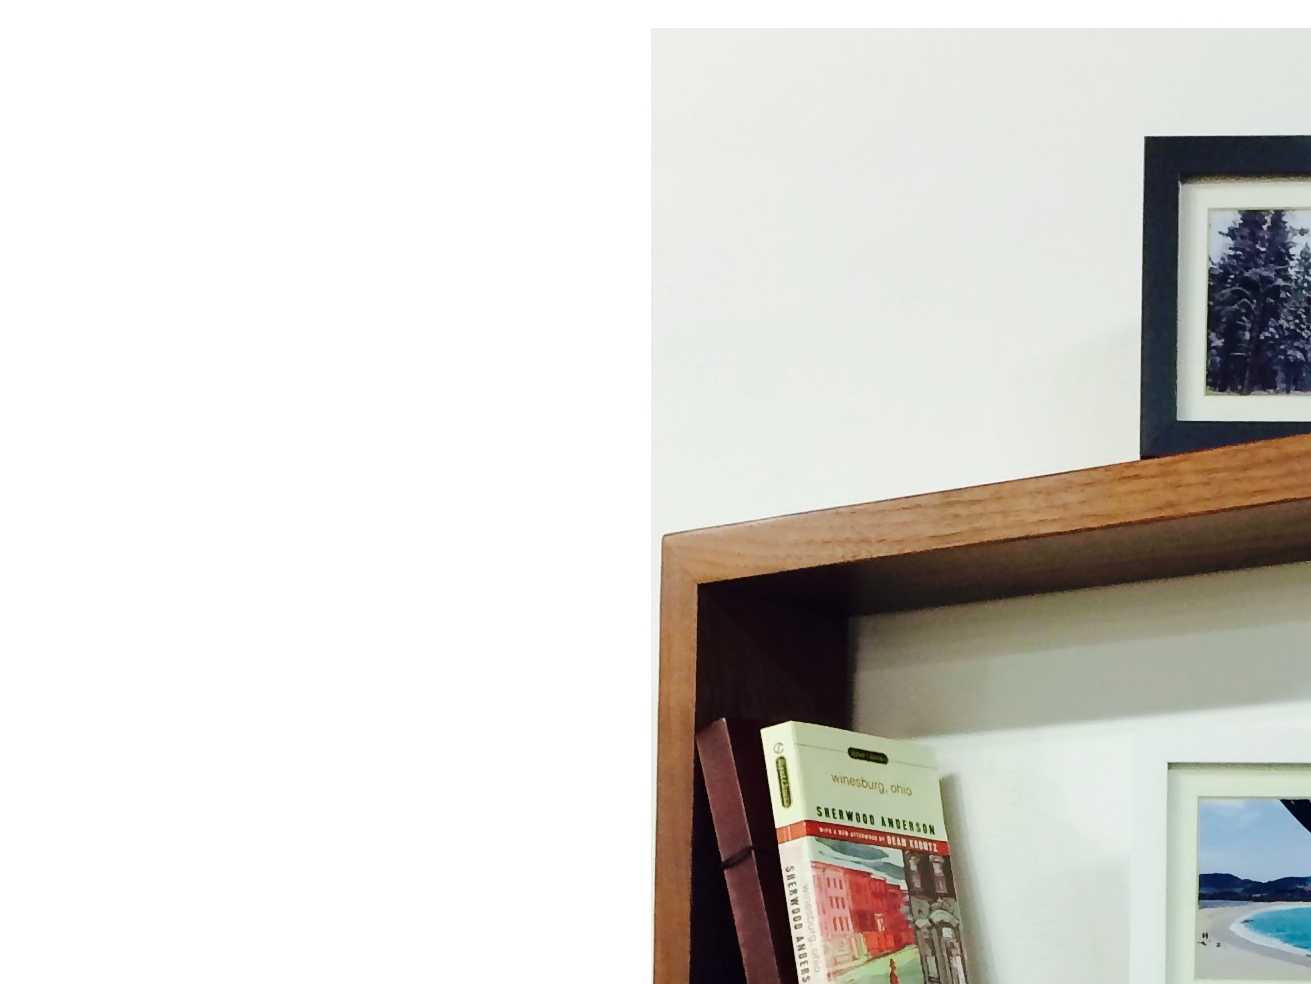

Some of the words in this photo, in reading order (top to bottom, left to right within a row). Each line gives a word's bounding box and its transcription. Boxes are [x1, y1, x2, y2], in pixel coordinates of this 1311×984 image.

[890, 783, 912, 796] ohio
[816, 806, 875, 826] SHERWOOD
[881, 816, 936, 835] ANDERSON
[886, 835, 908, 848] DEAN
[909, 838, 938, 853] KOONTZ
[785, 865, 803, 930] SHERWOOD
